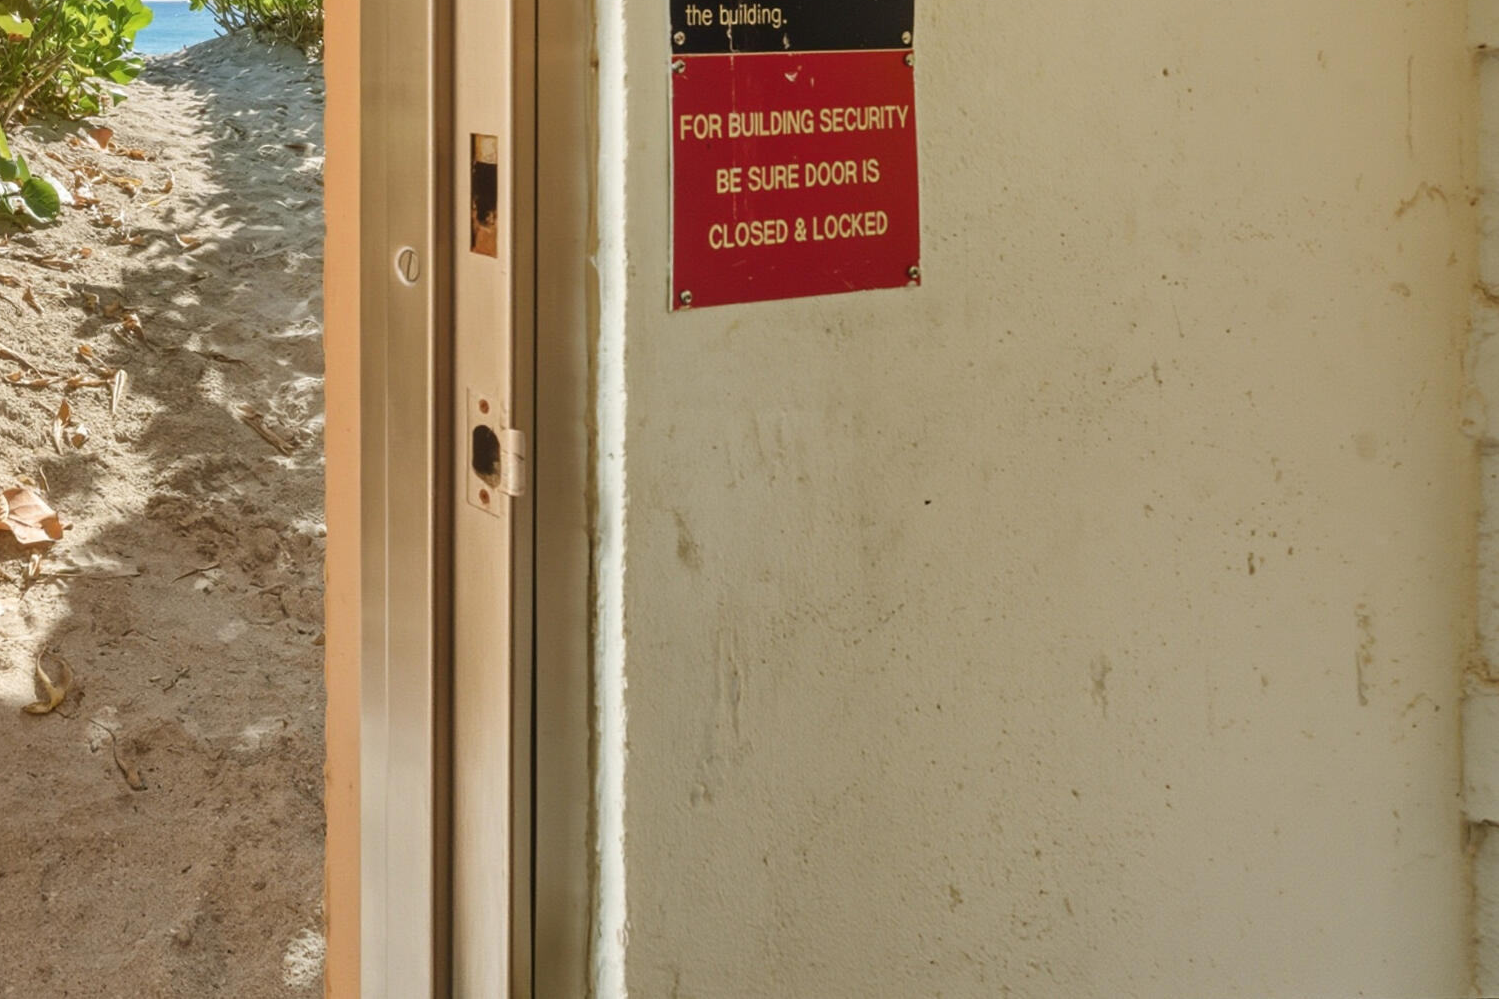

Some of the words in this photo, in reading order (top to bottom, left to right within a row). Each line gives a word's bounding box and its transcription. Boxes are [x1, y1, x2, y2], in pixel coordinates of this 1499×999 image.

[685, 4, 712, 26] the
[719, 4, 788, 28] building.
[680, 113, 722, 140] FOR
[728, 110, 814, 138] BUILDING
[820, 105, 909, 132] SECURITY
[716, 168, 742, 193] BE
[748, 164, 799, 192] SURE
[805, 160, 857, 187] DOOR
[863, 159, 880, 183] IS
[708, 220, 788, 249] CLOSED
[794, 218, 807, 242] &
[813, 211, 888, 240] LOCKED
